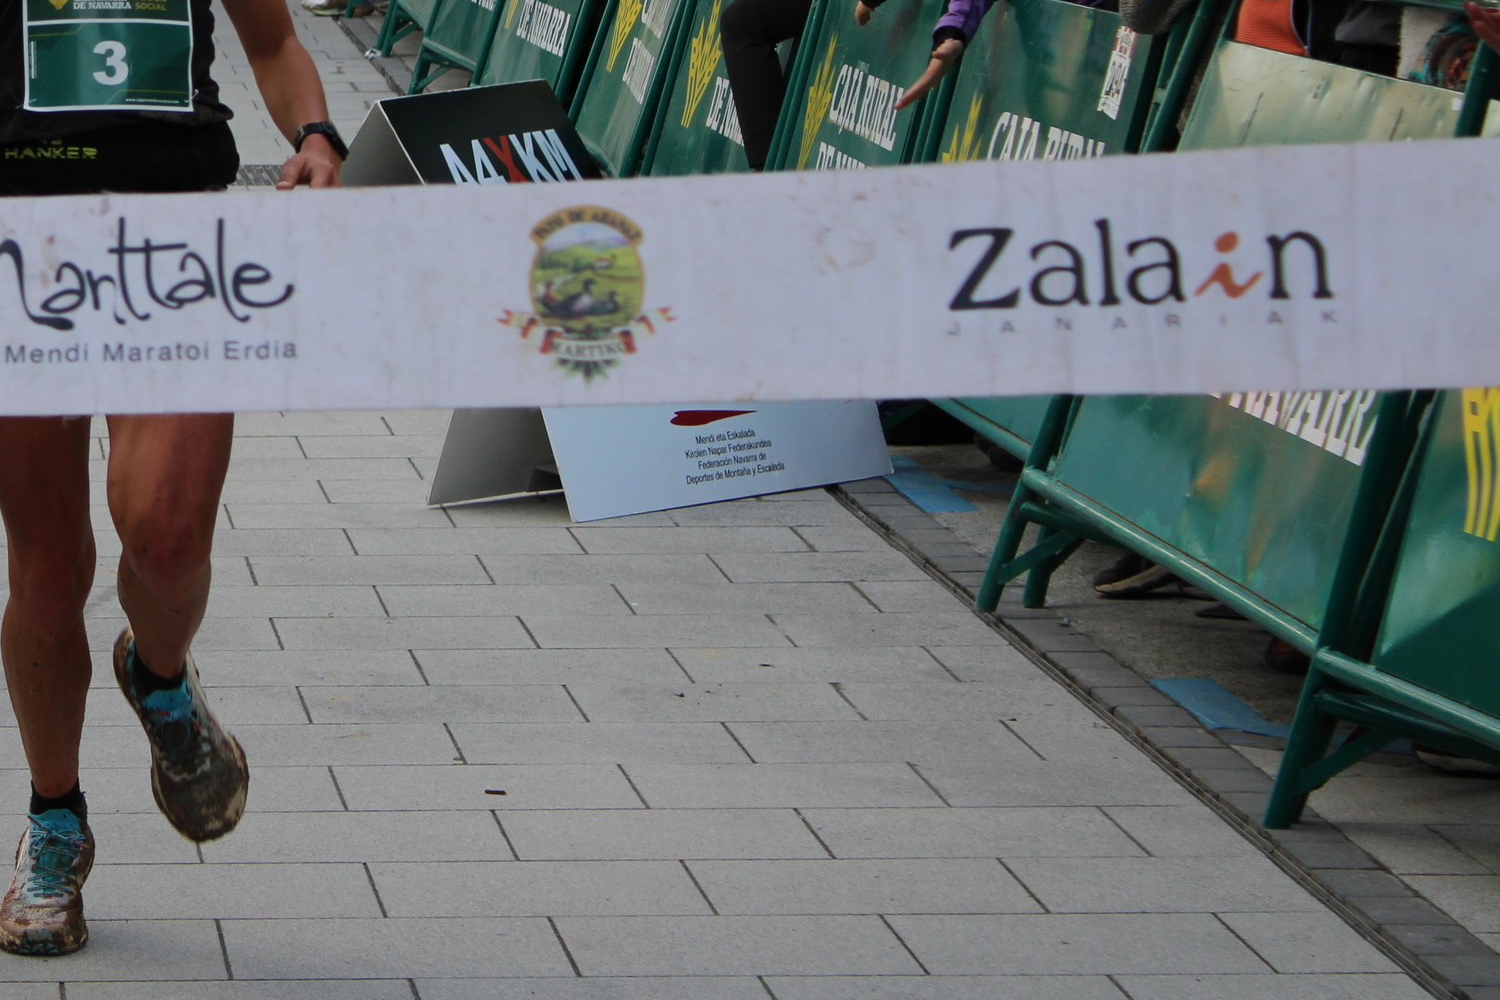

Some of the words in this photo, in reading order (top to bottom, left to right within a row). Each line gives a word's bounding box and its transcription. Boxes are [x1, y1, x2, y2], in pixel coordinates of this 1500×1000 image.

[73, 1, 87, 10] DE
[88, 1, 132, 10] NAVARRA
[135, 2, 167, 11] SOCIAL
[526, 0, 571, 57] NAVARRA
[92, 40, 129, 86] 3
[705, 76, 730, 131] DE
[829, 64, 865, 134] CAJA
[854, 74, 904, 152] RURAL
[5, 147, 97, 159] HANKER
[949, 219, 1334, 310] Zalain
[948, 310, 1339, 337] JANARIAK
[4, 344, 90, 364] Mendi
[103, 341, 210, 362] Maratoi
[223, 340, 297, 361] Erdia
[695, 434, 716, 445] Mendi
[716, 431, 727, 442] eta
[726, 427, 756, 441] Eskalada
[684, 447, 708, 459] Kirolen
[708, 445, 727, 457] Napar
[728, 438, 772, 453] Federakundea
[698, 457, 733, 470] Federación
[733, 454, 758, 465] Navarra
[758, 451, 767, 462] de
[686, 471, 715, 486] Deportes
[715, 470, 724, 481] de
[724, 466, 752, 479] Montaña
[757, 461, 786, 474] Escalada
